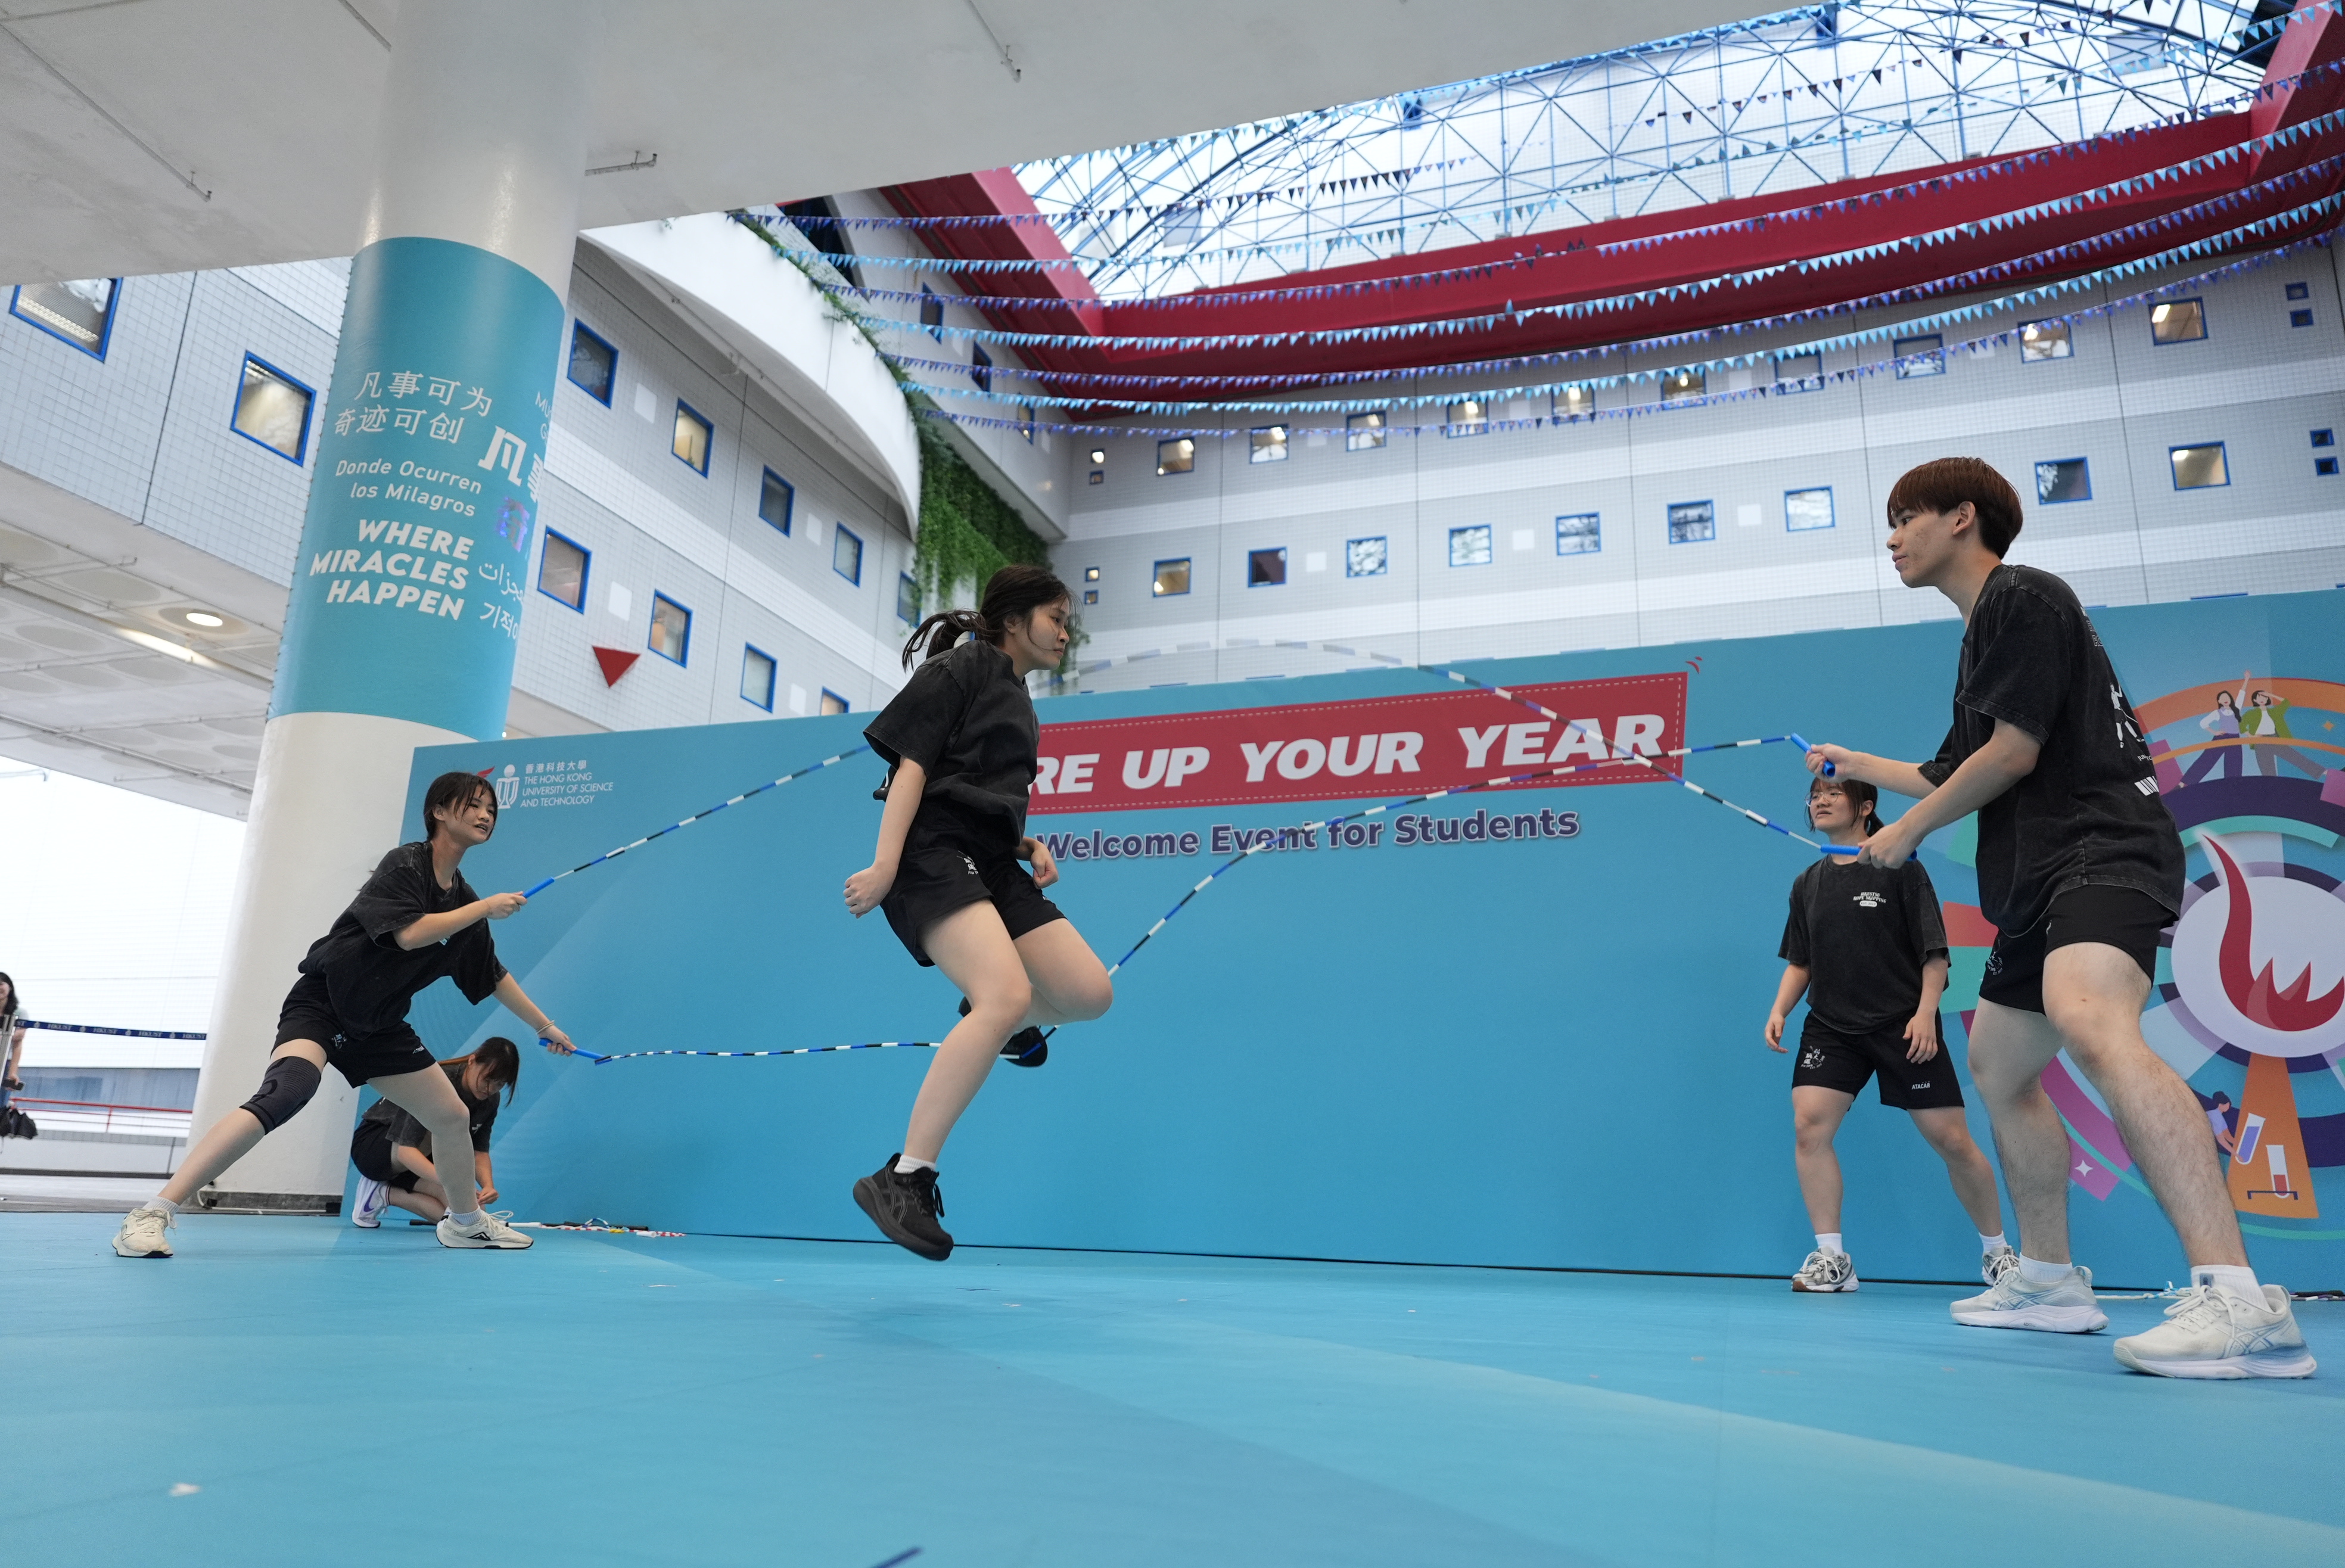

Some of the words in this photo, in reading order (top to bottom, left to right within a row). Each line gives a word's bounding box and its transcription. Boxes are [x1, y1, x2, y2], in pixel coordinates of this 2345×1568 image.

[354, 371, 492, 417] 凡事可为
[334, 405, 465, 443] 奇迹可创
[335, 458, 391, 476] Donde
[399, 461, 482, 494] Ocurren
[350, 482, 378, 498] los
[385, 483, 475, 517] Milagros
[359, 519, 474, 561] WHERE
[309, 549, 469, 590] MIRACLES
[326, 580, 465, 621] HAPPEN
[525, 760, 587, 774] 香港科技大學
[1122, 746, 1210, 790] UP
[1240, 732, 1424, 782] YOUR
[1458, 714, 1665, 769] YEAR
[522, 785, 565, 796] UNIVERSITY
[567, 785, 578, 793] OF
[580, 782, 614, 792] SCIENCE
[524, 776, 539, 785] THE
[539, 774, 565, 784] HONG
[567, 772, 592, 782] KONG
[520, 798, 539, 808] AND
[540, 795, 595, 806] TECHNOLOGY
[1035, 829, 1200, 861] Welcome
[1210, 821, 1317, 854] Event
[1329, 817, 1384, 848] for
[1395, 808, 1579, 847] Students
